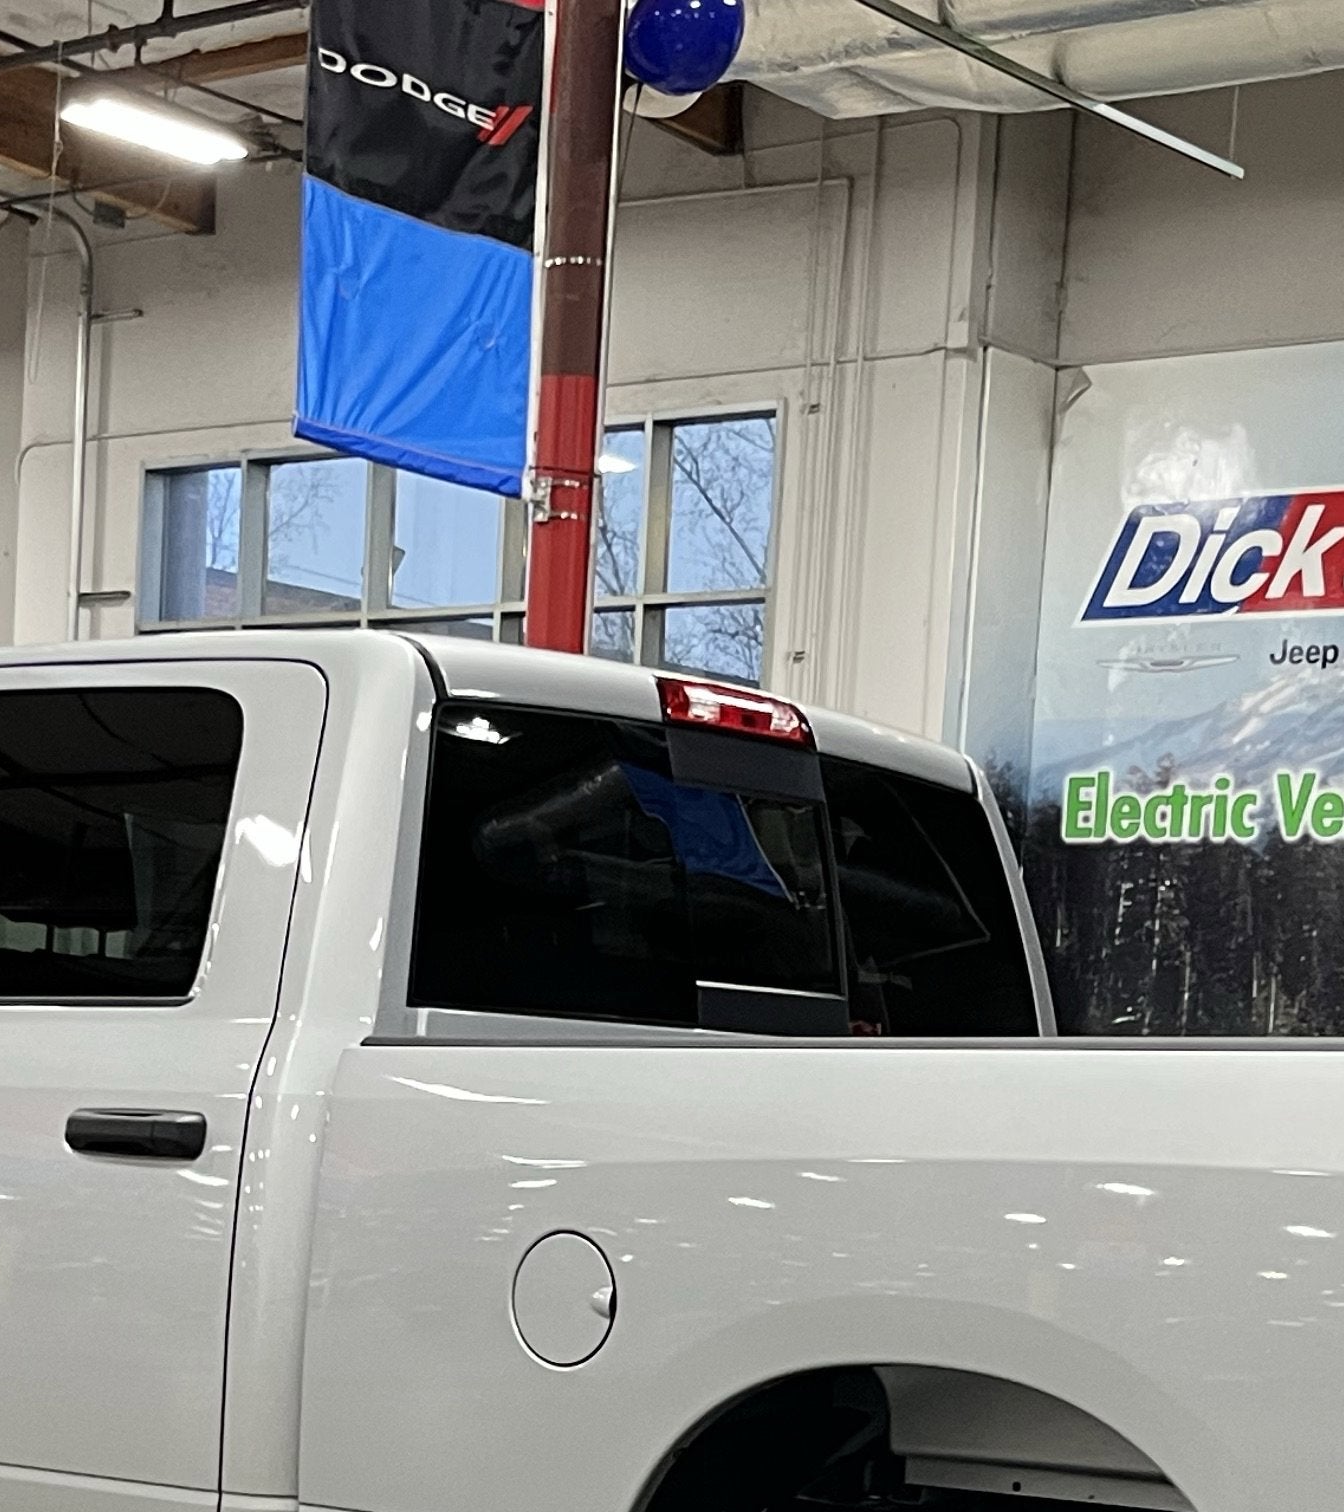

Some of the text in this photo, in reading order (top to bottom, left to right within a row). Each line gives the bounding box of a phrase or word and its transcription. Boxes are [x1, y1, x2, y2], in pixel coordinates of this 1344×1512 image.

[317, 46, 497, 132] DODGE
[1269, 638, 1340, 669] Jeep
[1064, 771, 1256, 839] Electric
